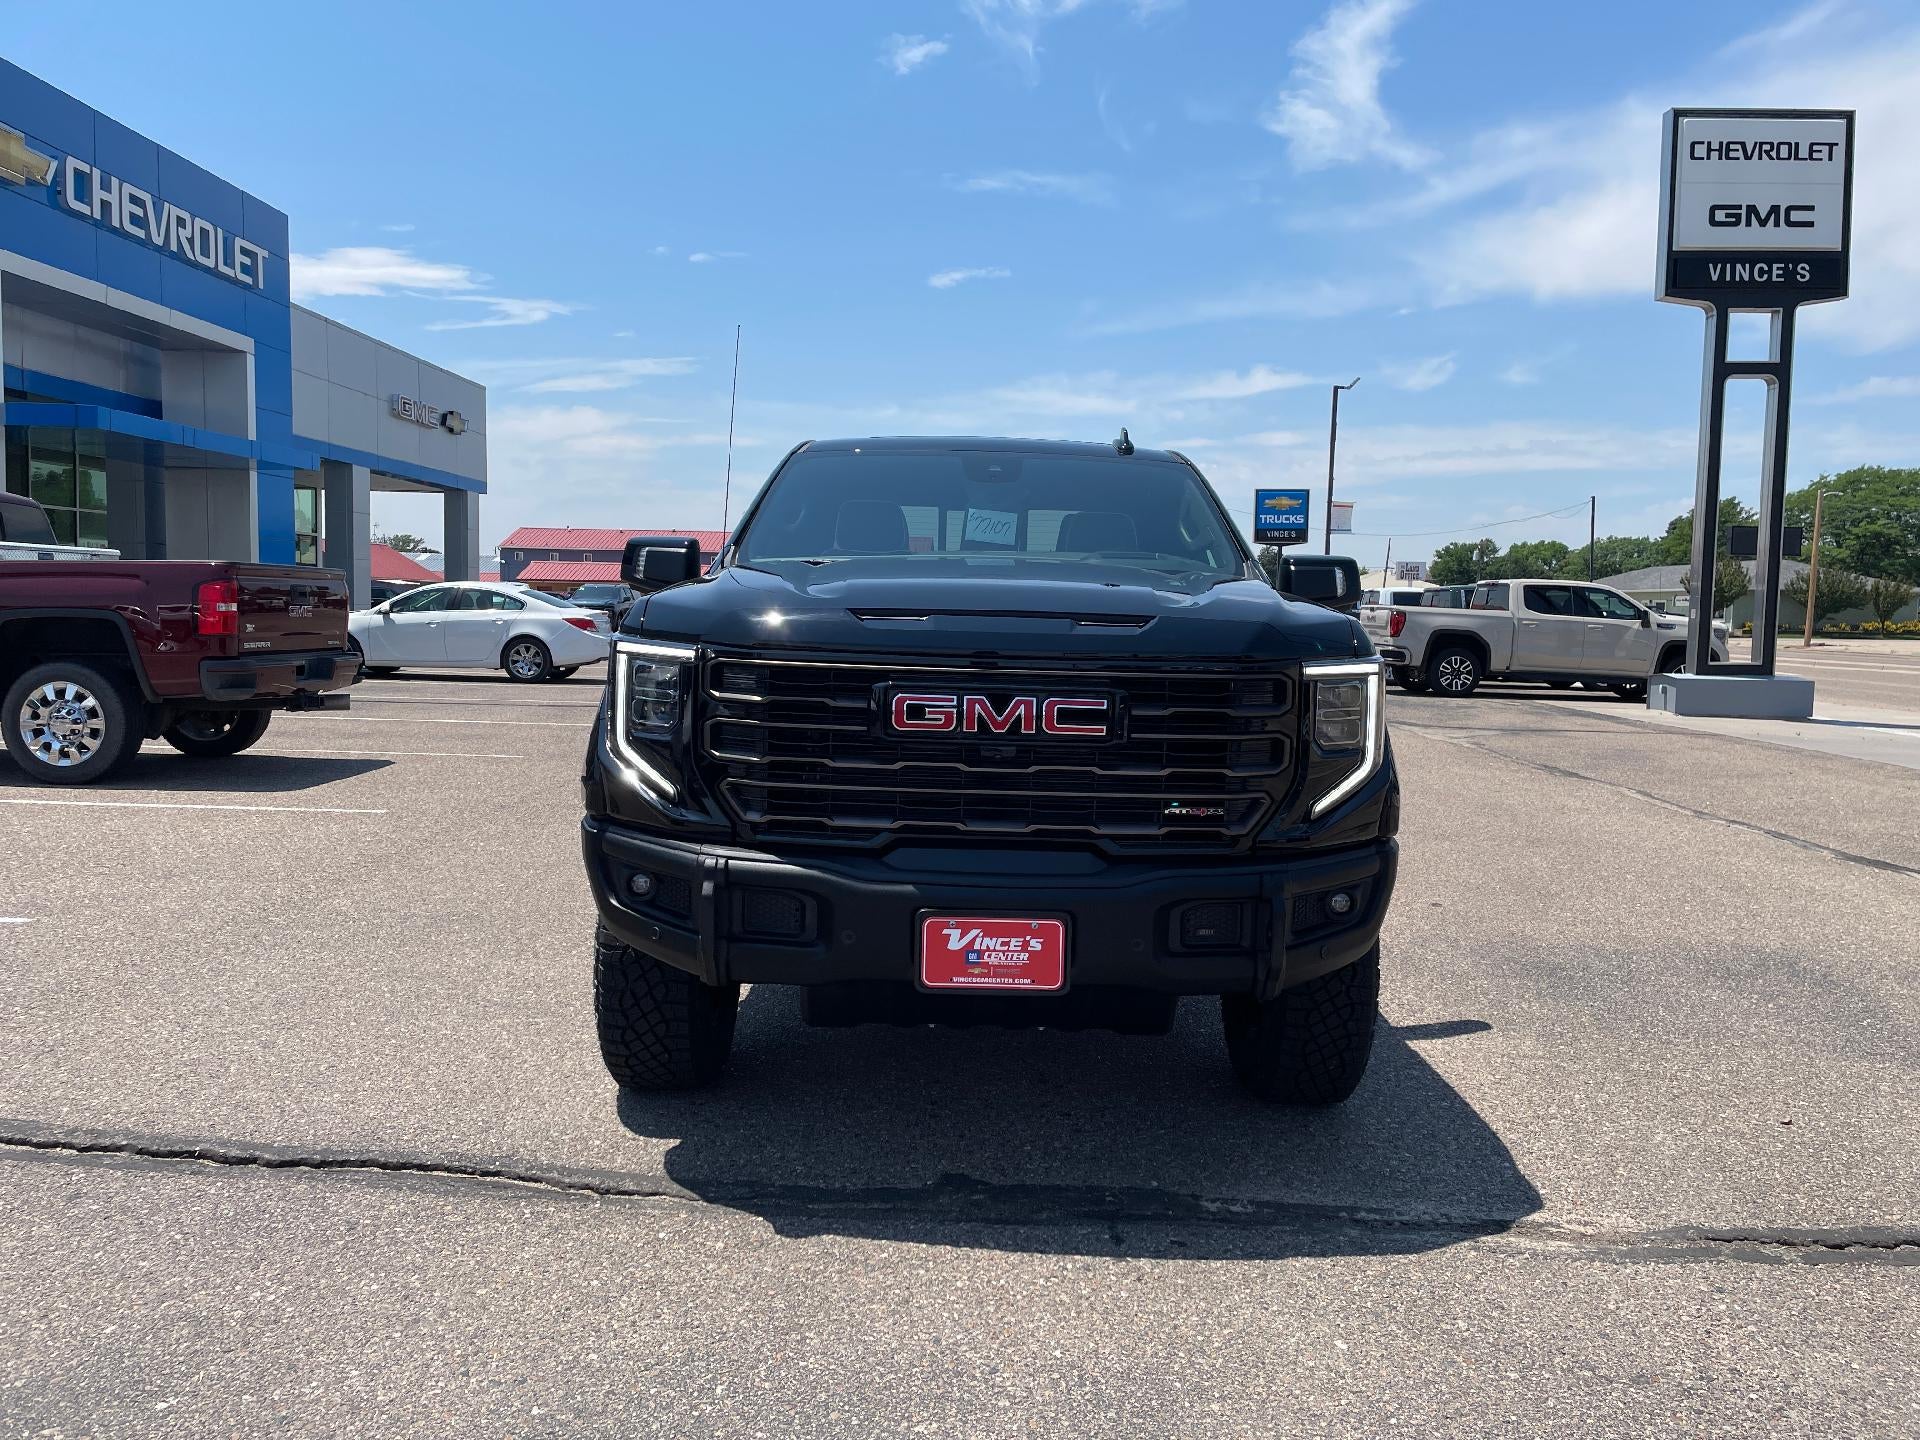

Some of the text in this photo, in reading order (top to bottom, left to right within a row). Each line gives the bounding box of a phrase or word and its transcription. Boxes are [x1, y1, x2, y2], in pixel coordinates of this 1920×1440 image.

[1690, 141, 1839, 161] CHEVROLET
[64, 155, 269, 289] CHEVROLET
[1708, 204, 1815, 228] GMC
[1708, 263, 1811, 282] VINCE'S
[396, 394, 440, 429] GMC
[1259, 515, 1304, 524] TRUCKS
[1266, 530, 1296, 538] VINCE'S
[892, 693, 1107, 735] GMC
[983, 951, 1030, 961] CENTER
